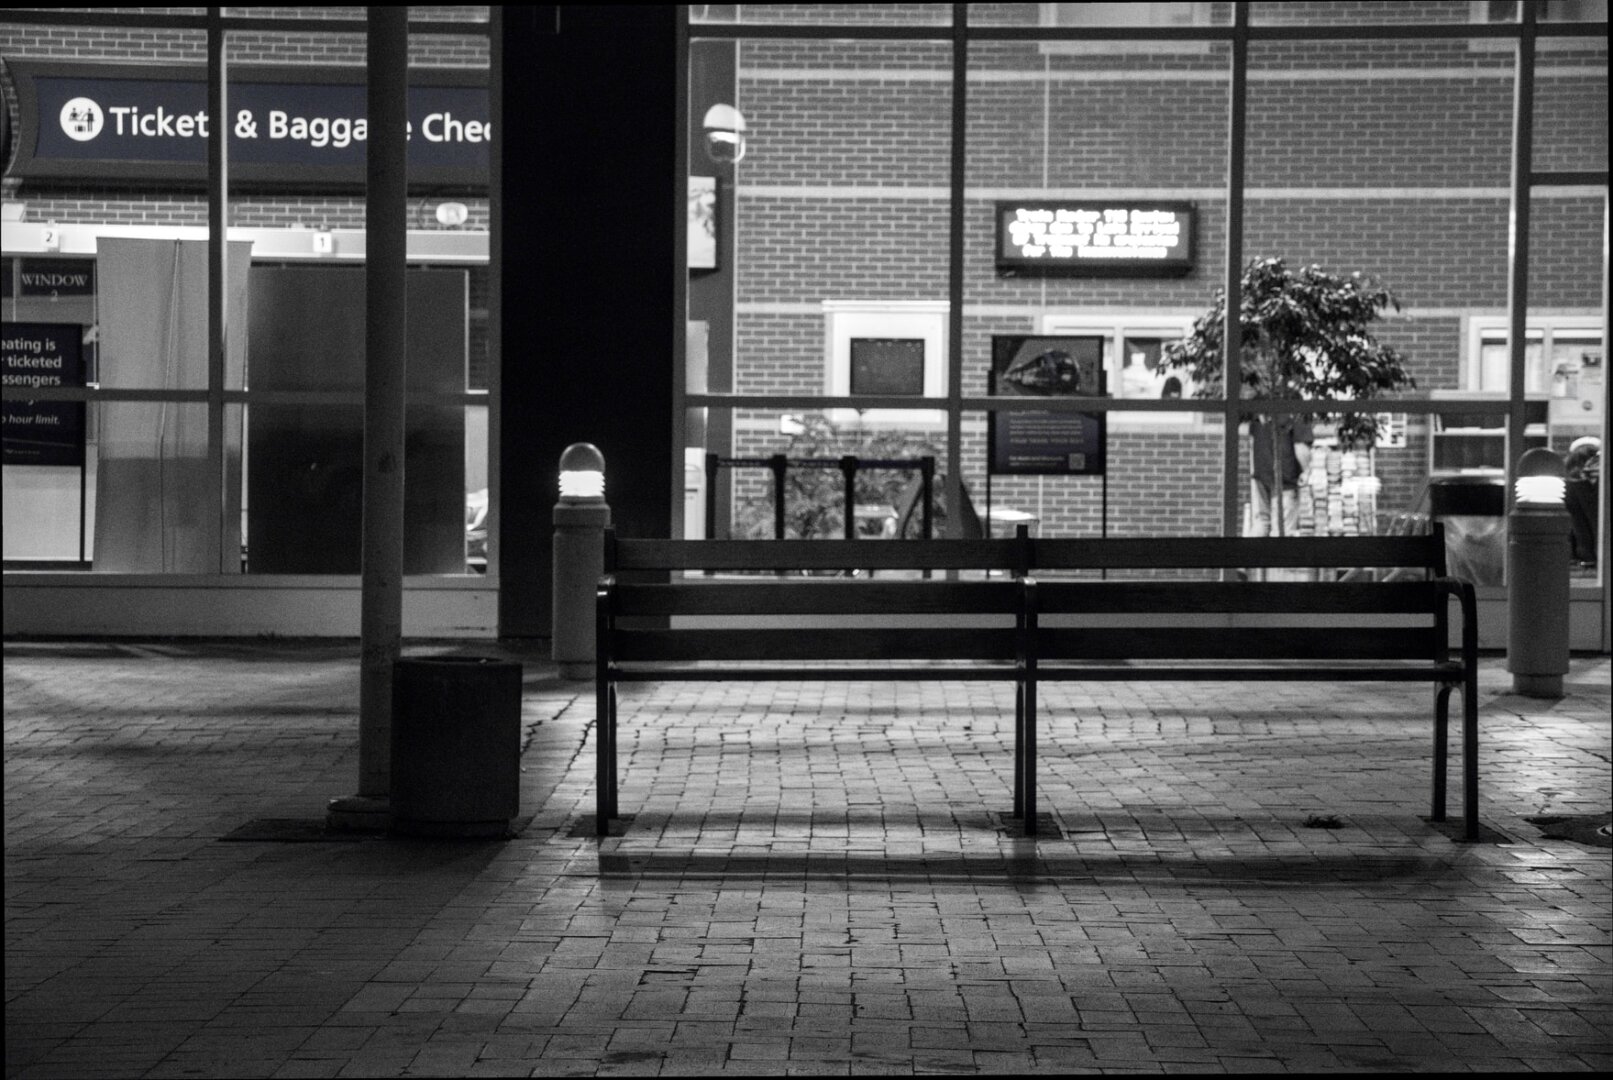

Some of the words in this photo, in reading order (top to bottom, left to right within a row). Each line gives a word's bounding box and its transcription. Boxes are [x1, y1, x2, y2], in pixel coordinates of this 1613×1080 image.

[109, 106, 209, 138] Ticket
[234, 109, 257, 138] &
[269, 110, 412, 148] Bagga
[45, 232, 53, 243] 2
[21, 273, 88, 287] WINDOW
[45, 337, 56, 351] is
[7, 354, 63, 369] ticketed
[9, 413, 33, 425] hour
[35, 413, 60, 425] limit.
